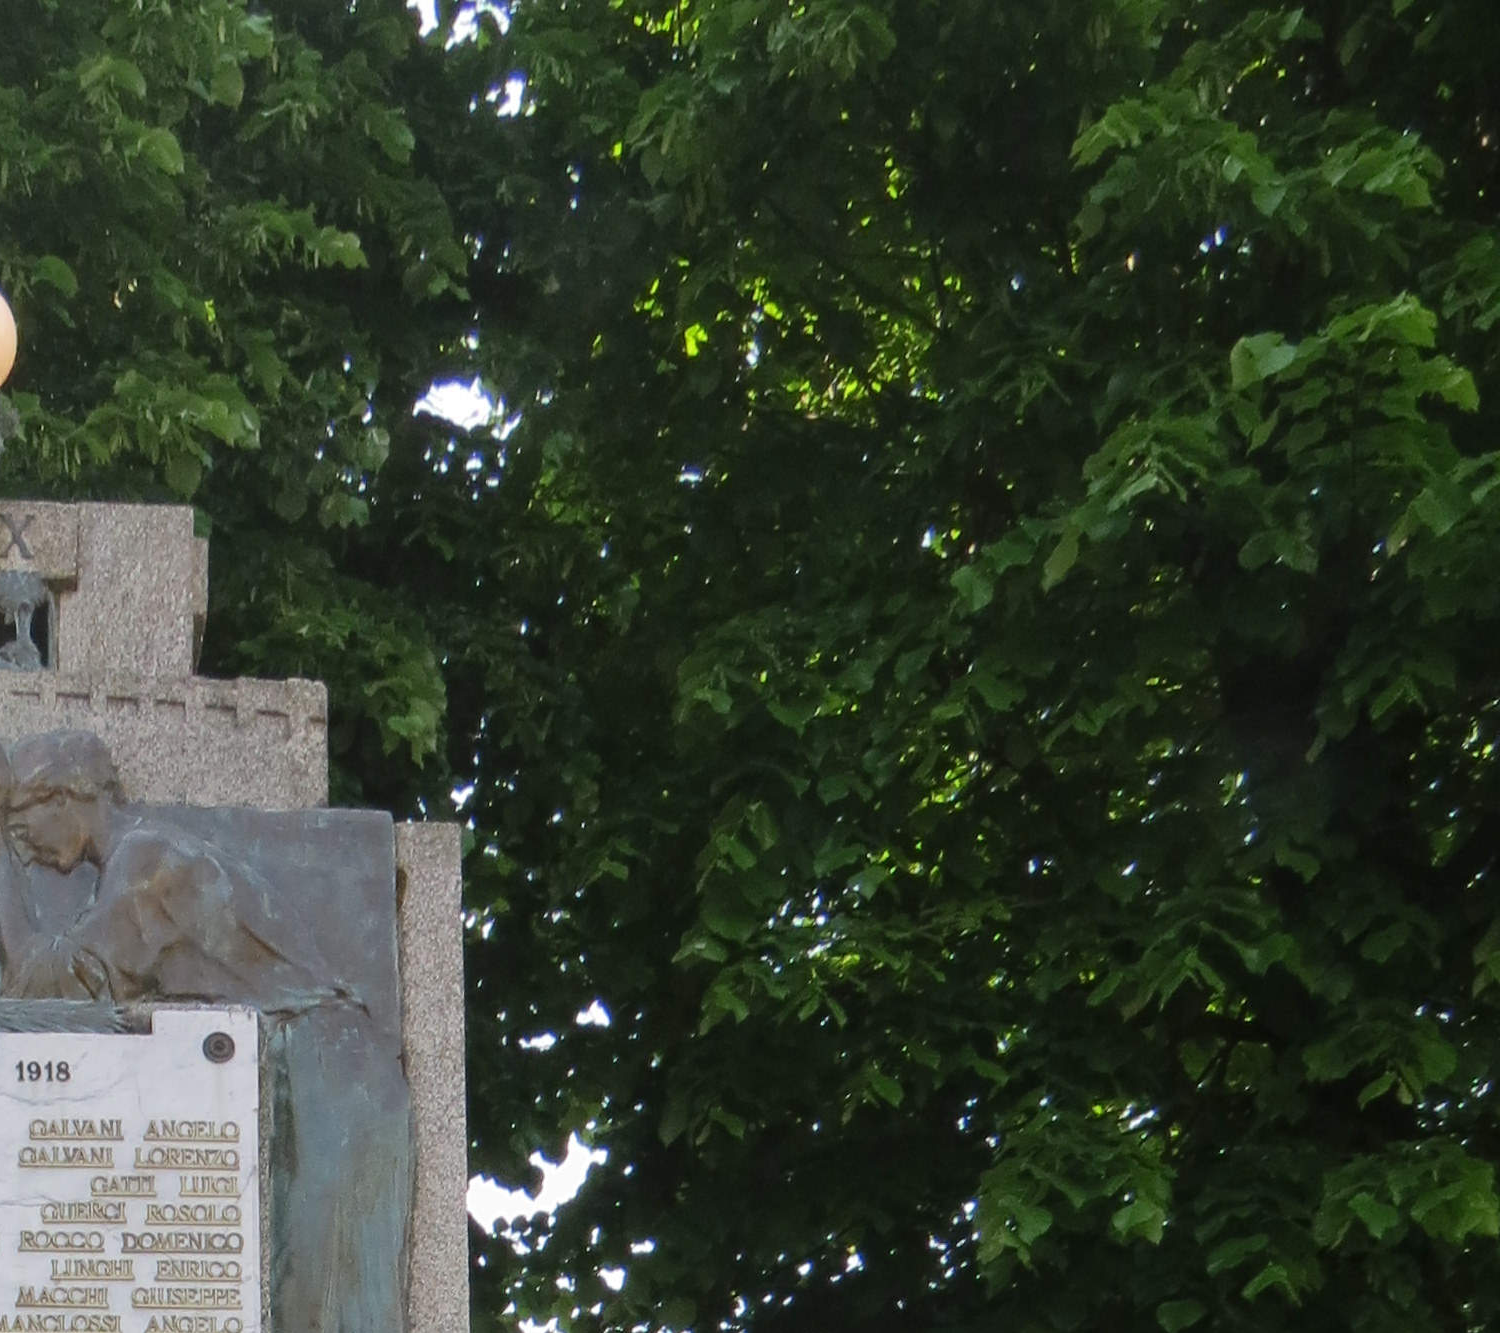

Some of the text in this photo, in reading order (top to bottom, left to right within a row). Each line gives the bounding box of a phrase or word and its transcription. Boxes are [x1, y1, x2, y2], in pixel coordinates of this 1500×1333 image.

[16, 1060, 71, 1082] 1918
[91, 1176, 240, 1197] GATTI LUIGI
[18, 1230, 104, 1252] ROCCO
[121, 1232, 243, 1253] DOMENICO
